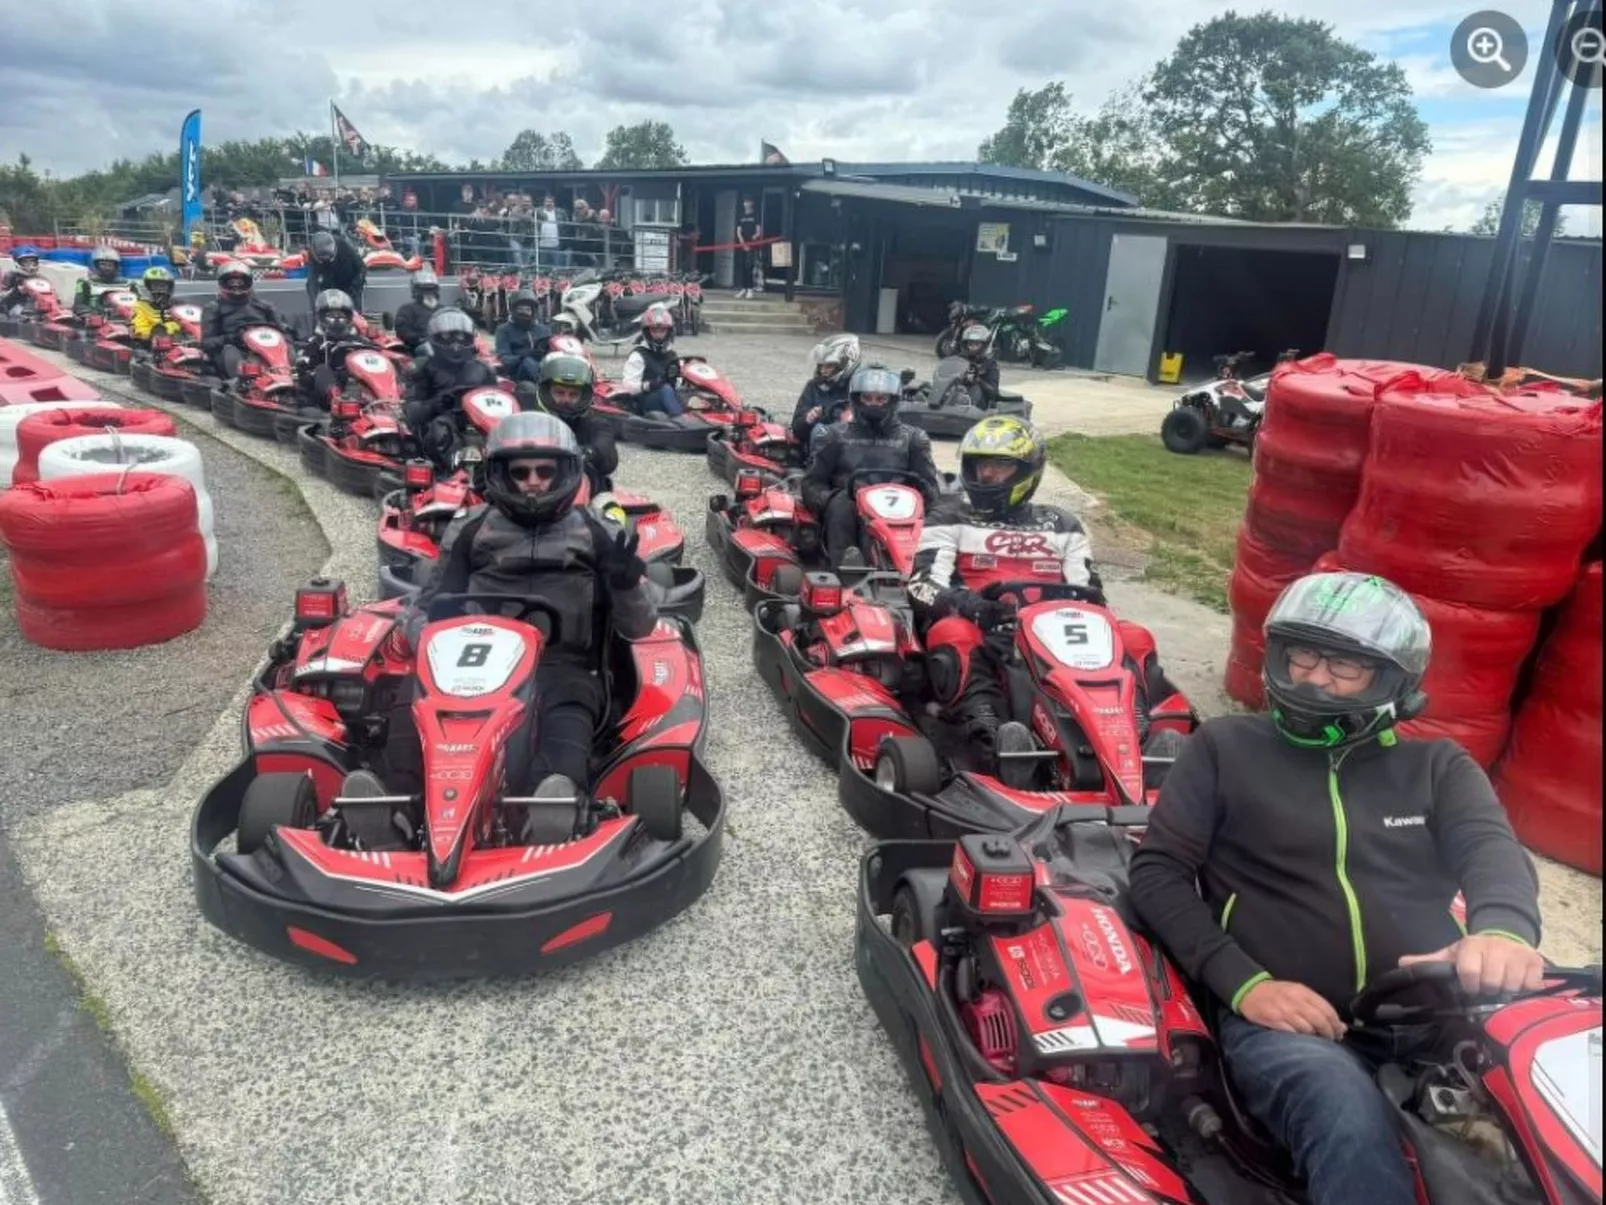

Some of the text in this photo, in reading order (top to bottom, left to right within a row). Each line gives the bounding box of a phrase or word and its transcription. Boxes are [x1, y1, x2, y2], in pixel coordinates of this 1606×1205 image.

[885, 495, 899, 507] 7
[1064, 624, 1089, 645] 5
[456, 643, 492, 668] 8
[1091, 906, 1132, 975] HONDA
